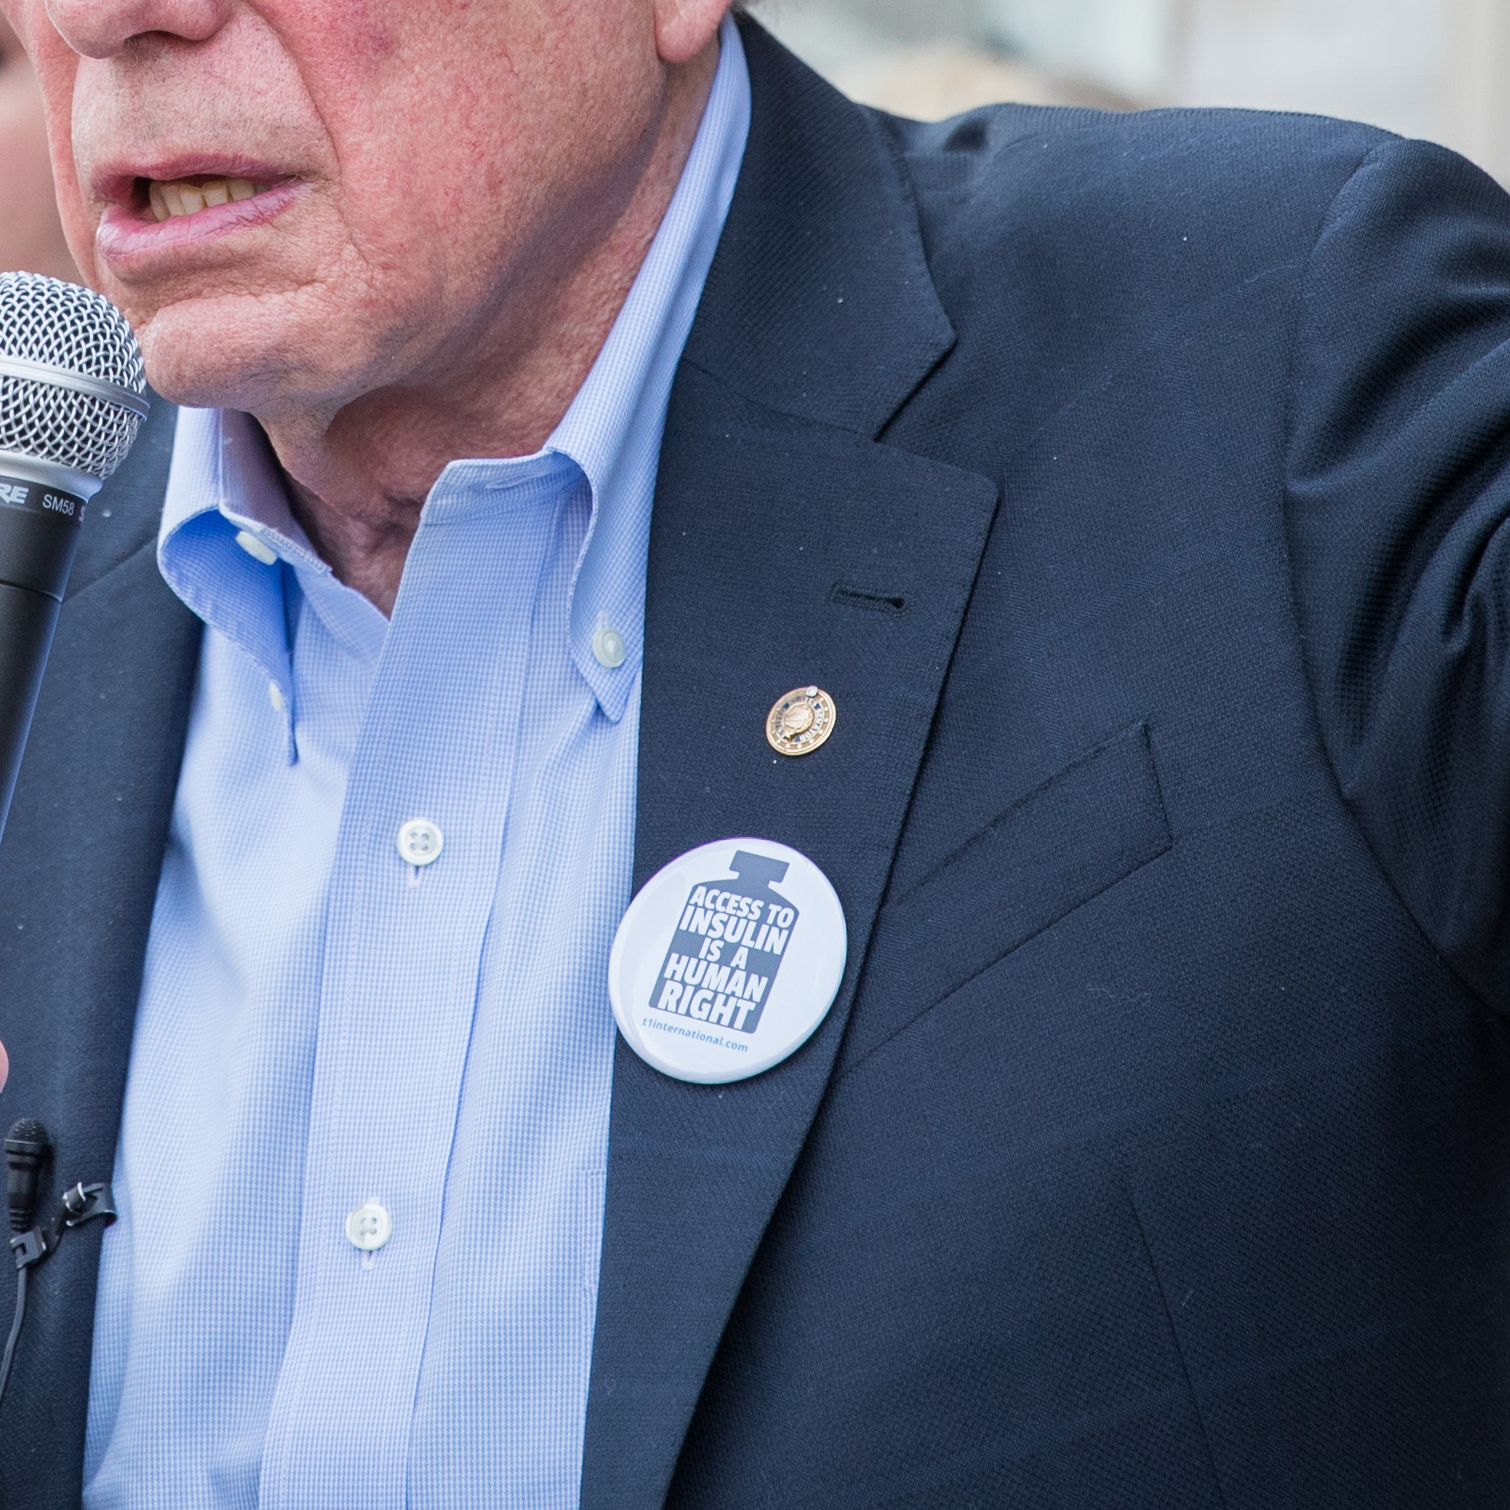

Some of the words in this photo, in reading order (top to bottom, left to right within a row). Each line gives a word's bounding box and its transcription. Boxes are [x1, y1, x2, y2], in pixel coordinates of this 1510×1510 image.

[42, 494, 75, 516] SM58
[690, 886, 764, 921] ACCESS
[766, 903, 795, 928] TO
[679, 905, 789, 955] INSULIN
[698, 937, 724, 962] IS
[730, 946, 749, 970] A
[663, 953, 769, 1002] HUMAN
[657, 980, 757, 1031] RIGHT
[642, 1017, 748, 1053] t1international.com
